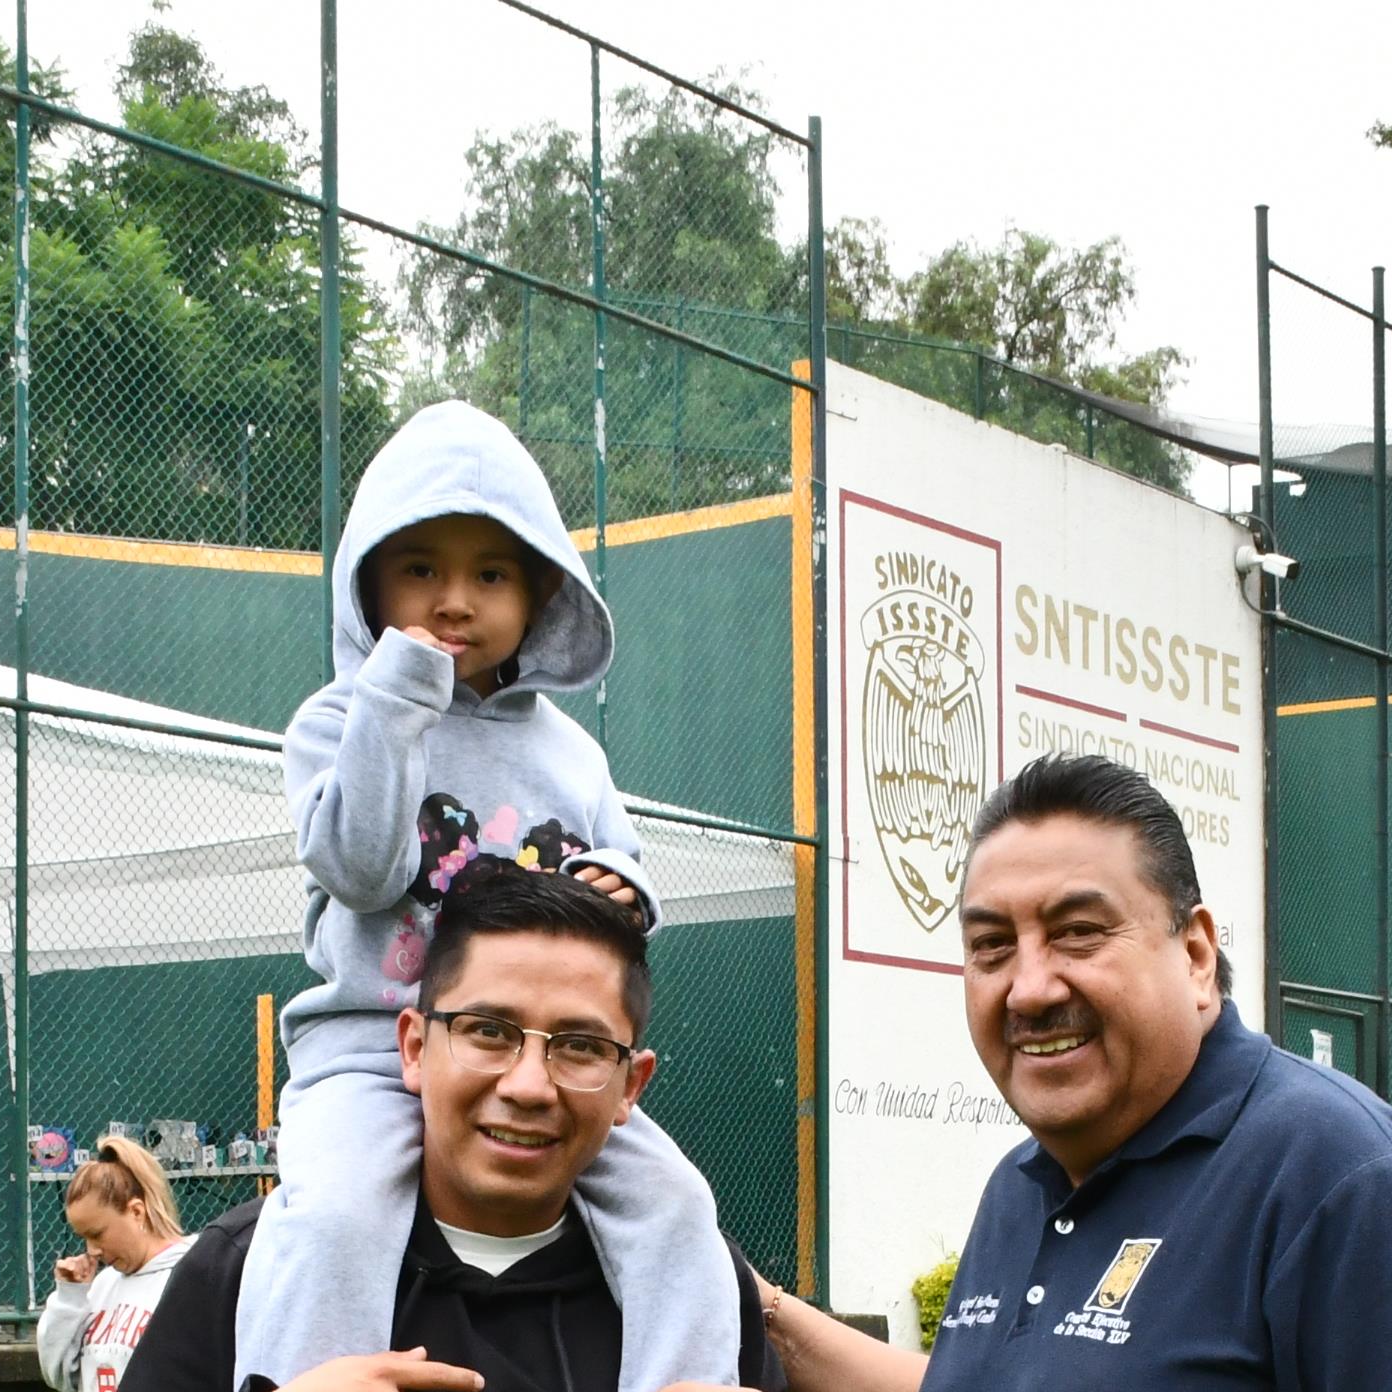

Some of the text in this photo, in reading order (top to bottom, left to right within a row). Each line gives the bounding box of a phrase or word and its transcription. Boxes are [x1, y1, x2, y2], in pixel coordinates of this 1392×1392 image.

[874, 551, 973, 619] SINDICATO
[876, 601, 970, 661] ISSSTE
[1014, 584, 1241, 716] SNTISSSTE
[1018, 711, 1241, 802] SINDICATO NACIONAL
[1177, 805, 1230, 847] ORES
[834, 1078, 869, 1117] Con
